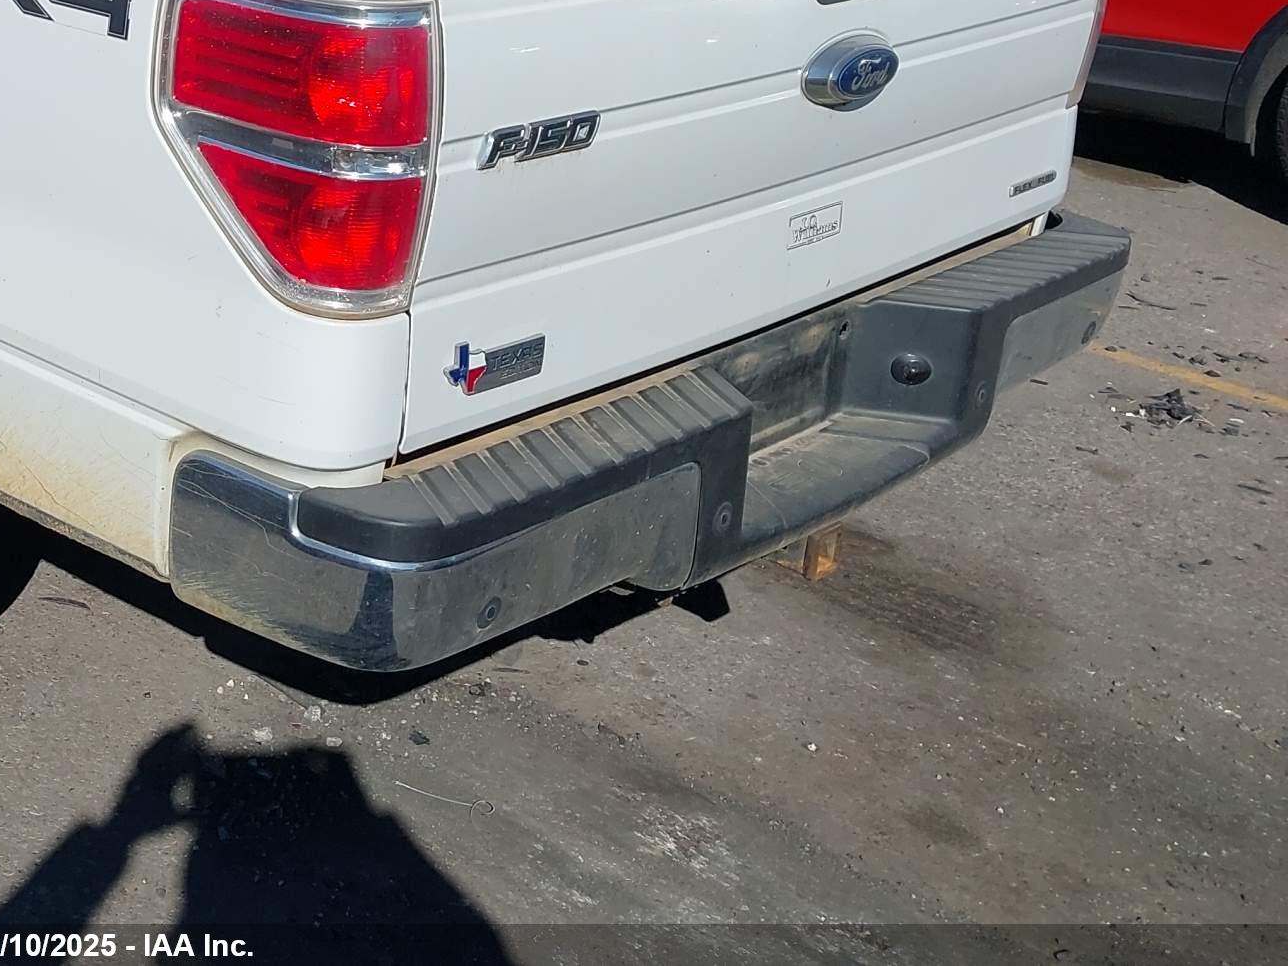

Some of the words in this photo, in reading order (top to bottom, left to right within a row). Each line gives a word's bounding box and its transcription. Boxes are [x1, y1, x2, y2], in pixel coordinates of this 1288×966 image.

[850, 56, 892, 92] Ford
[475, 109, 601, 171] F-150
[490, 343, 545, 372] TEXAS
